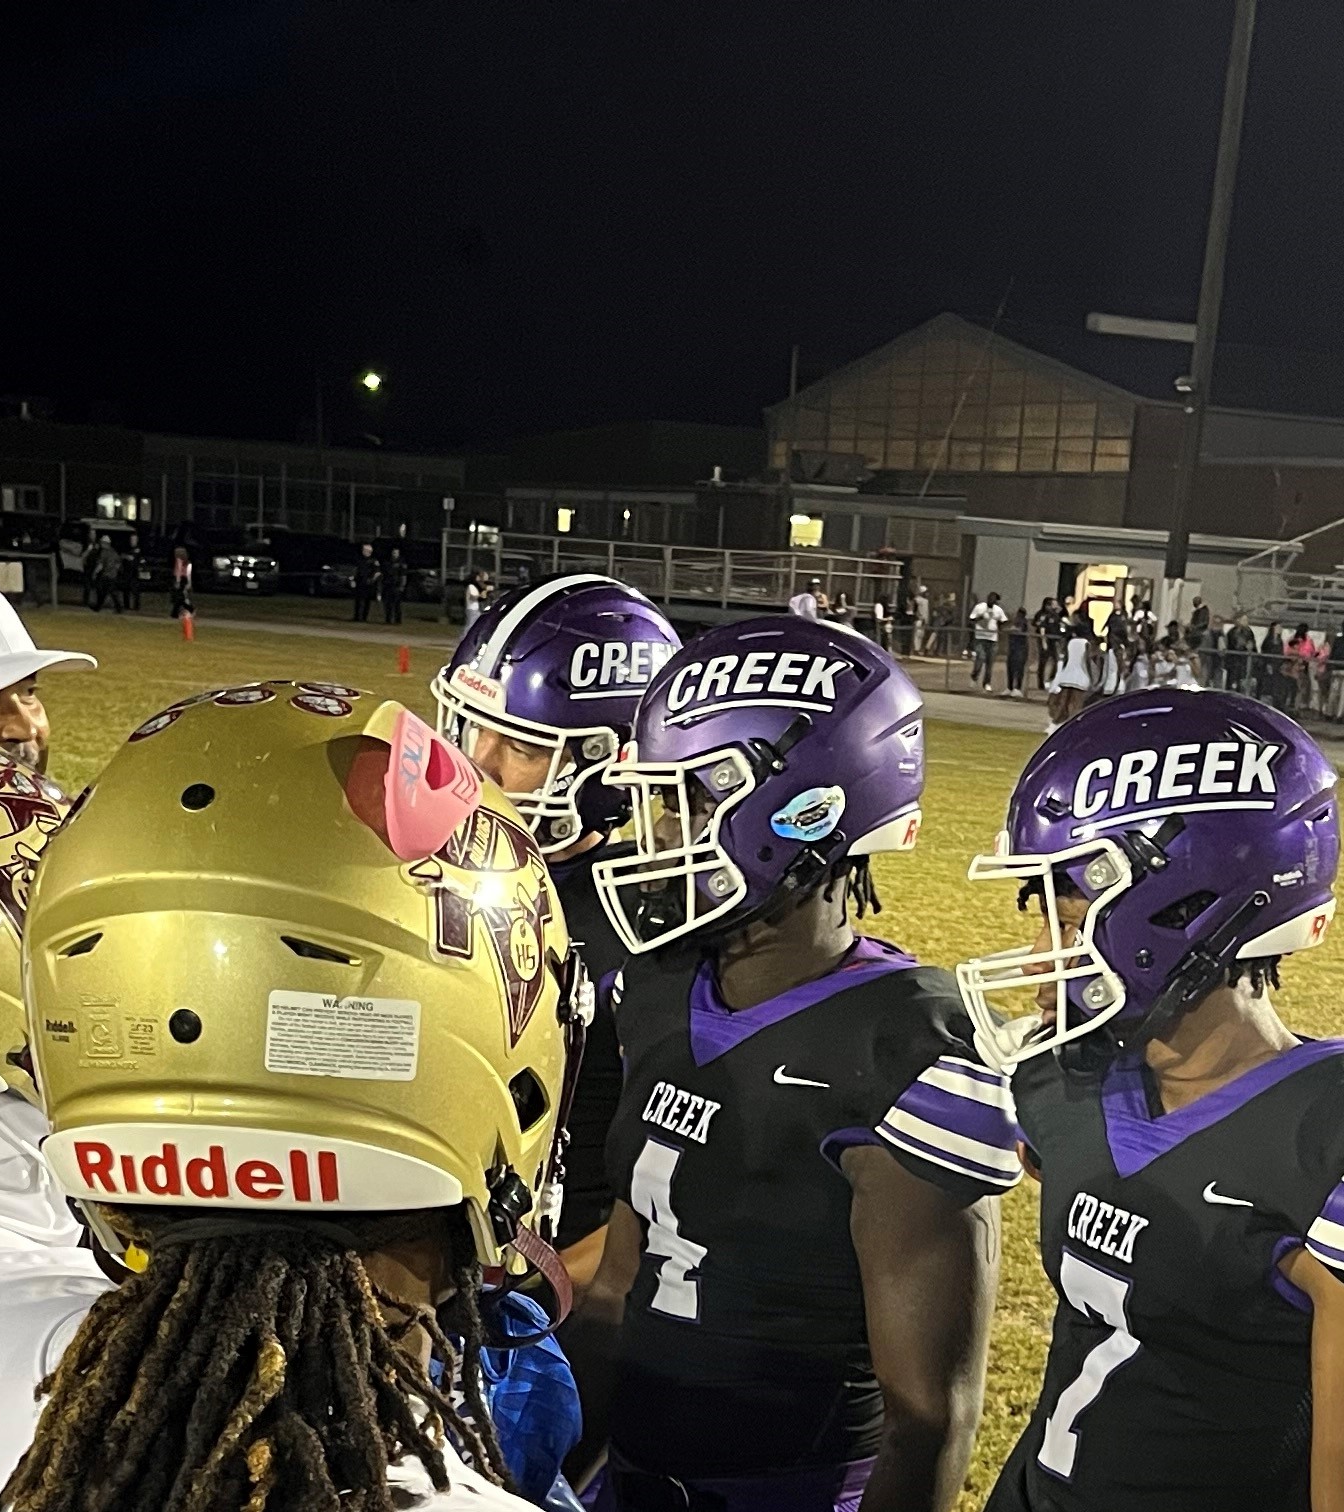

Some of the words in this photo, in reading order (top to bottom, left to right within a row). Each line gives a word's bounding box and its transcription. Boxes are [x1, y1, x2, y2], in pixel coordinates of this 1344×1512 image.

[457, 668, 497, 699] Riddell
[570, 641, 678, 688] CREE
[667, 652, 852, 712] CREEK
[1071, 741, 1283, 820] CREEK
[516, 943, 536, 971] HS
[322, 998, 374, 1012] WANING
[642, 1081, 722, 1145] CREEK
[74, 1140, 341, 1204] Riddell
[1067, 1190, 1150, 1265] CREEK
[1036, 1246, 1142, 1484] 7
